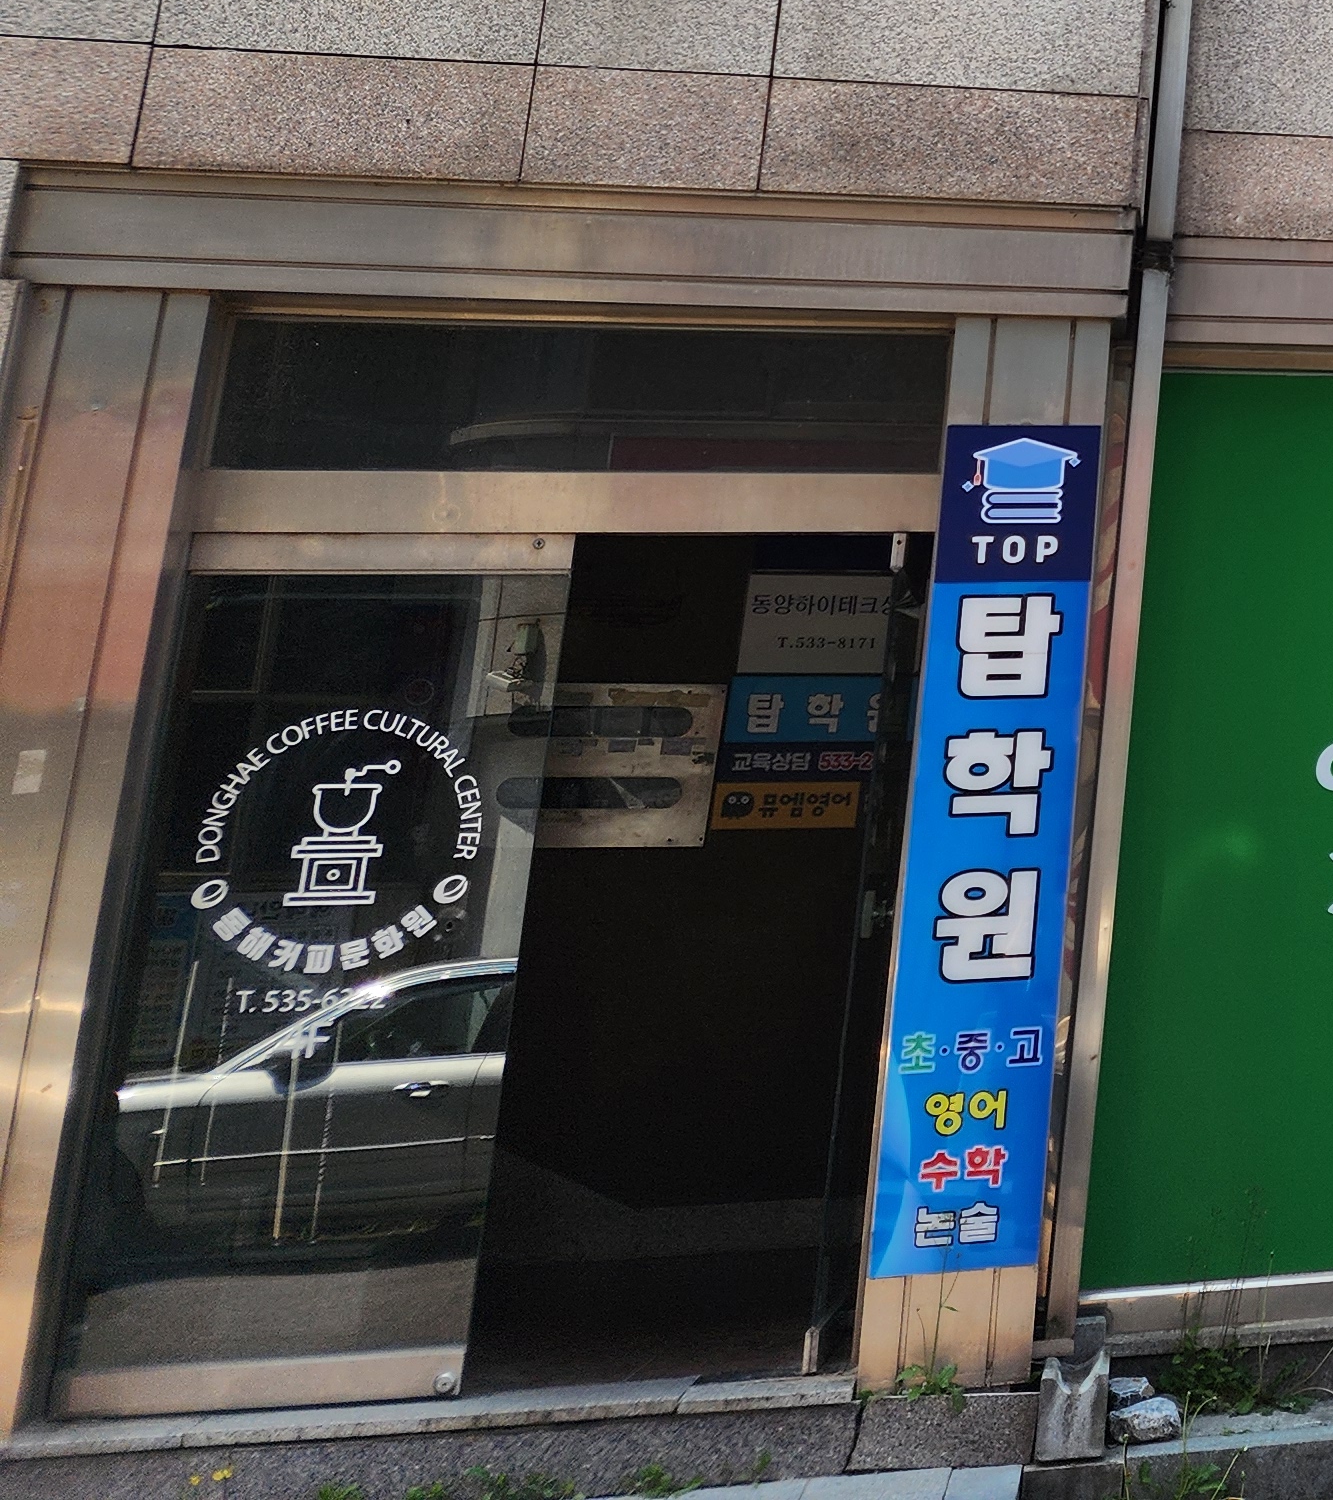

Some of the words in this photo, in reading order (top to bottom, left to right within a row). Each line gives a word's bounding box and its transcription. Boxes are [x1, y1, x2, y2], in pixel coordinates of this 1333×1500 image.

[970, 534, 1059, 564] TOP
[751, 594, 892, 616] 동양하이테크
[195, 748, 271, 864] DONGHAE
[265, 708, 360, 756] COFFEE
[362, 708, 466, 775] CULTURAL
[452, 773, 483, 861] CENTER
[731, 752, 811, 773] 교육상담
[757, 791, 852, 819] 뮤엠영어
[932, 593, 1063, 984] 탑학원
[212, 904, 438, 975] 동해커피문화원
[924, 1088, 1009, 1137] 영어
[917, 1145, 1008, 1192] 수학
[913, 1201, 1001, 1249] 논술
